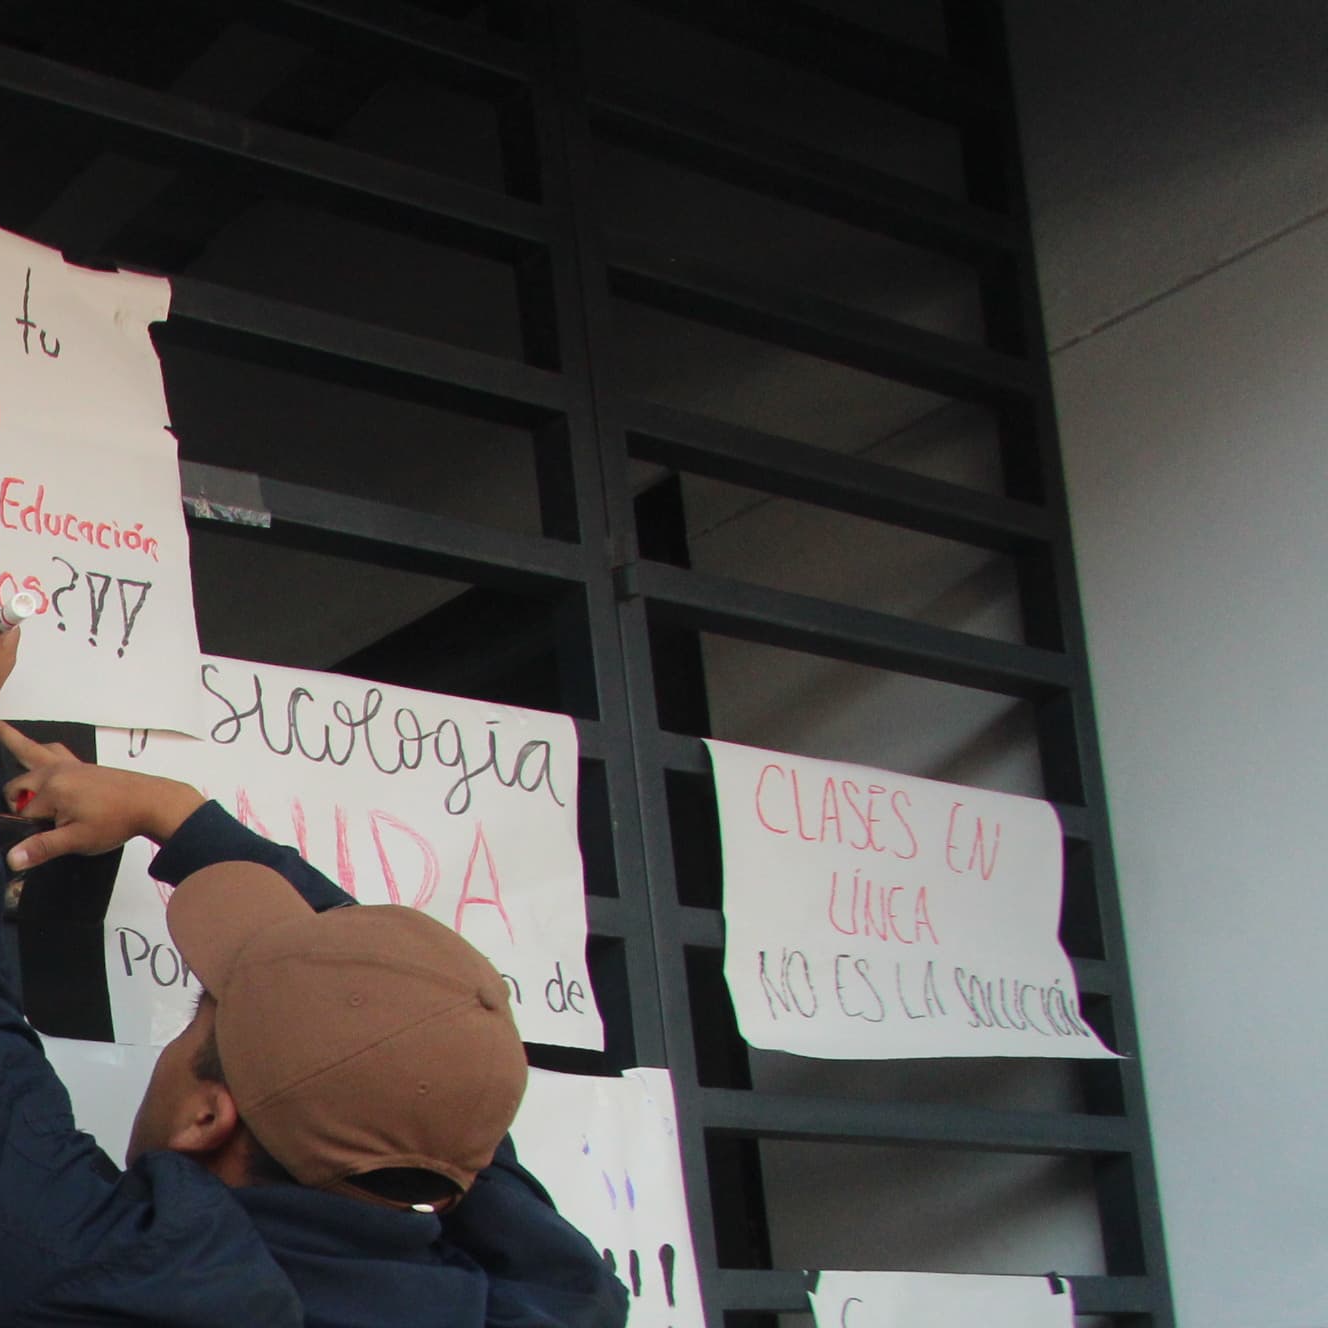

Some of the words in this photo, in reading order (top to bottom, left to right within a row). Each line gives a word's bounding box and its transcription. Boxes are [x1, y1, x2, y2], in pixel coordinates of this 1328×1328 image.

[15, 267, 62, 359] tu
[129, 662, 566, 816] sicología
[754, 763, 920, 861] CLASES
[945, 801, 1002, 882] EN
[544, 960, 586, 1015] de
[758, 947, 819, 1021] NO
[834, 953, 886, 1024] ES
[895, 960, 947, 1020] LA
